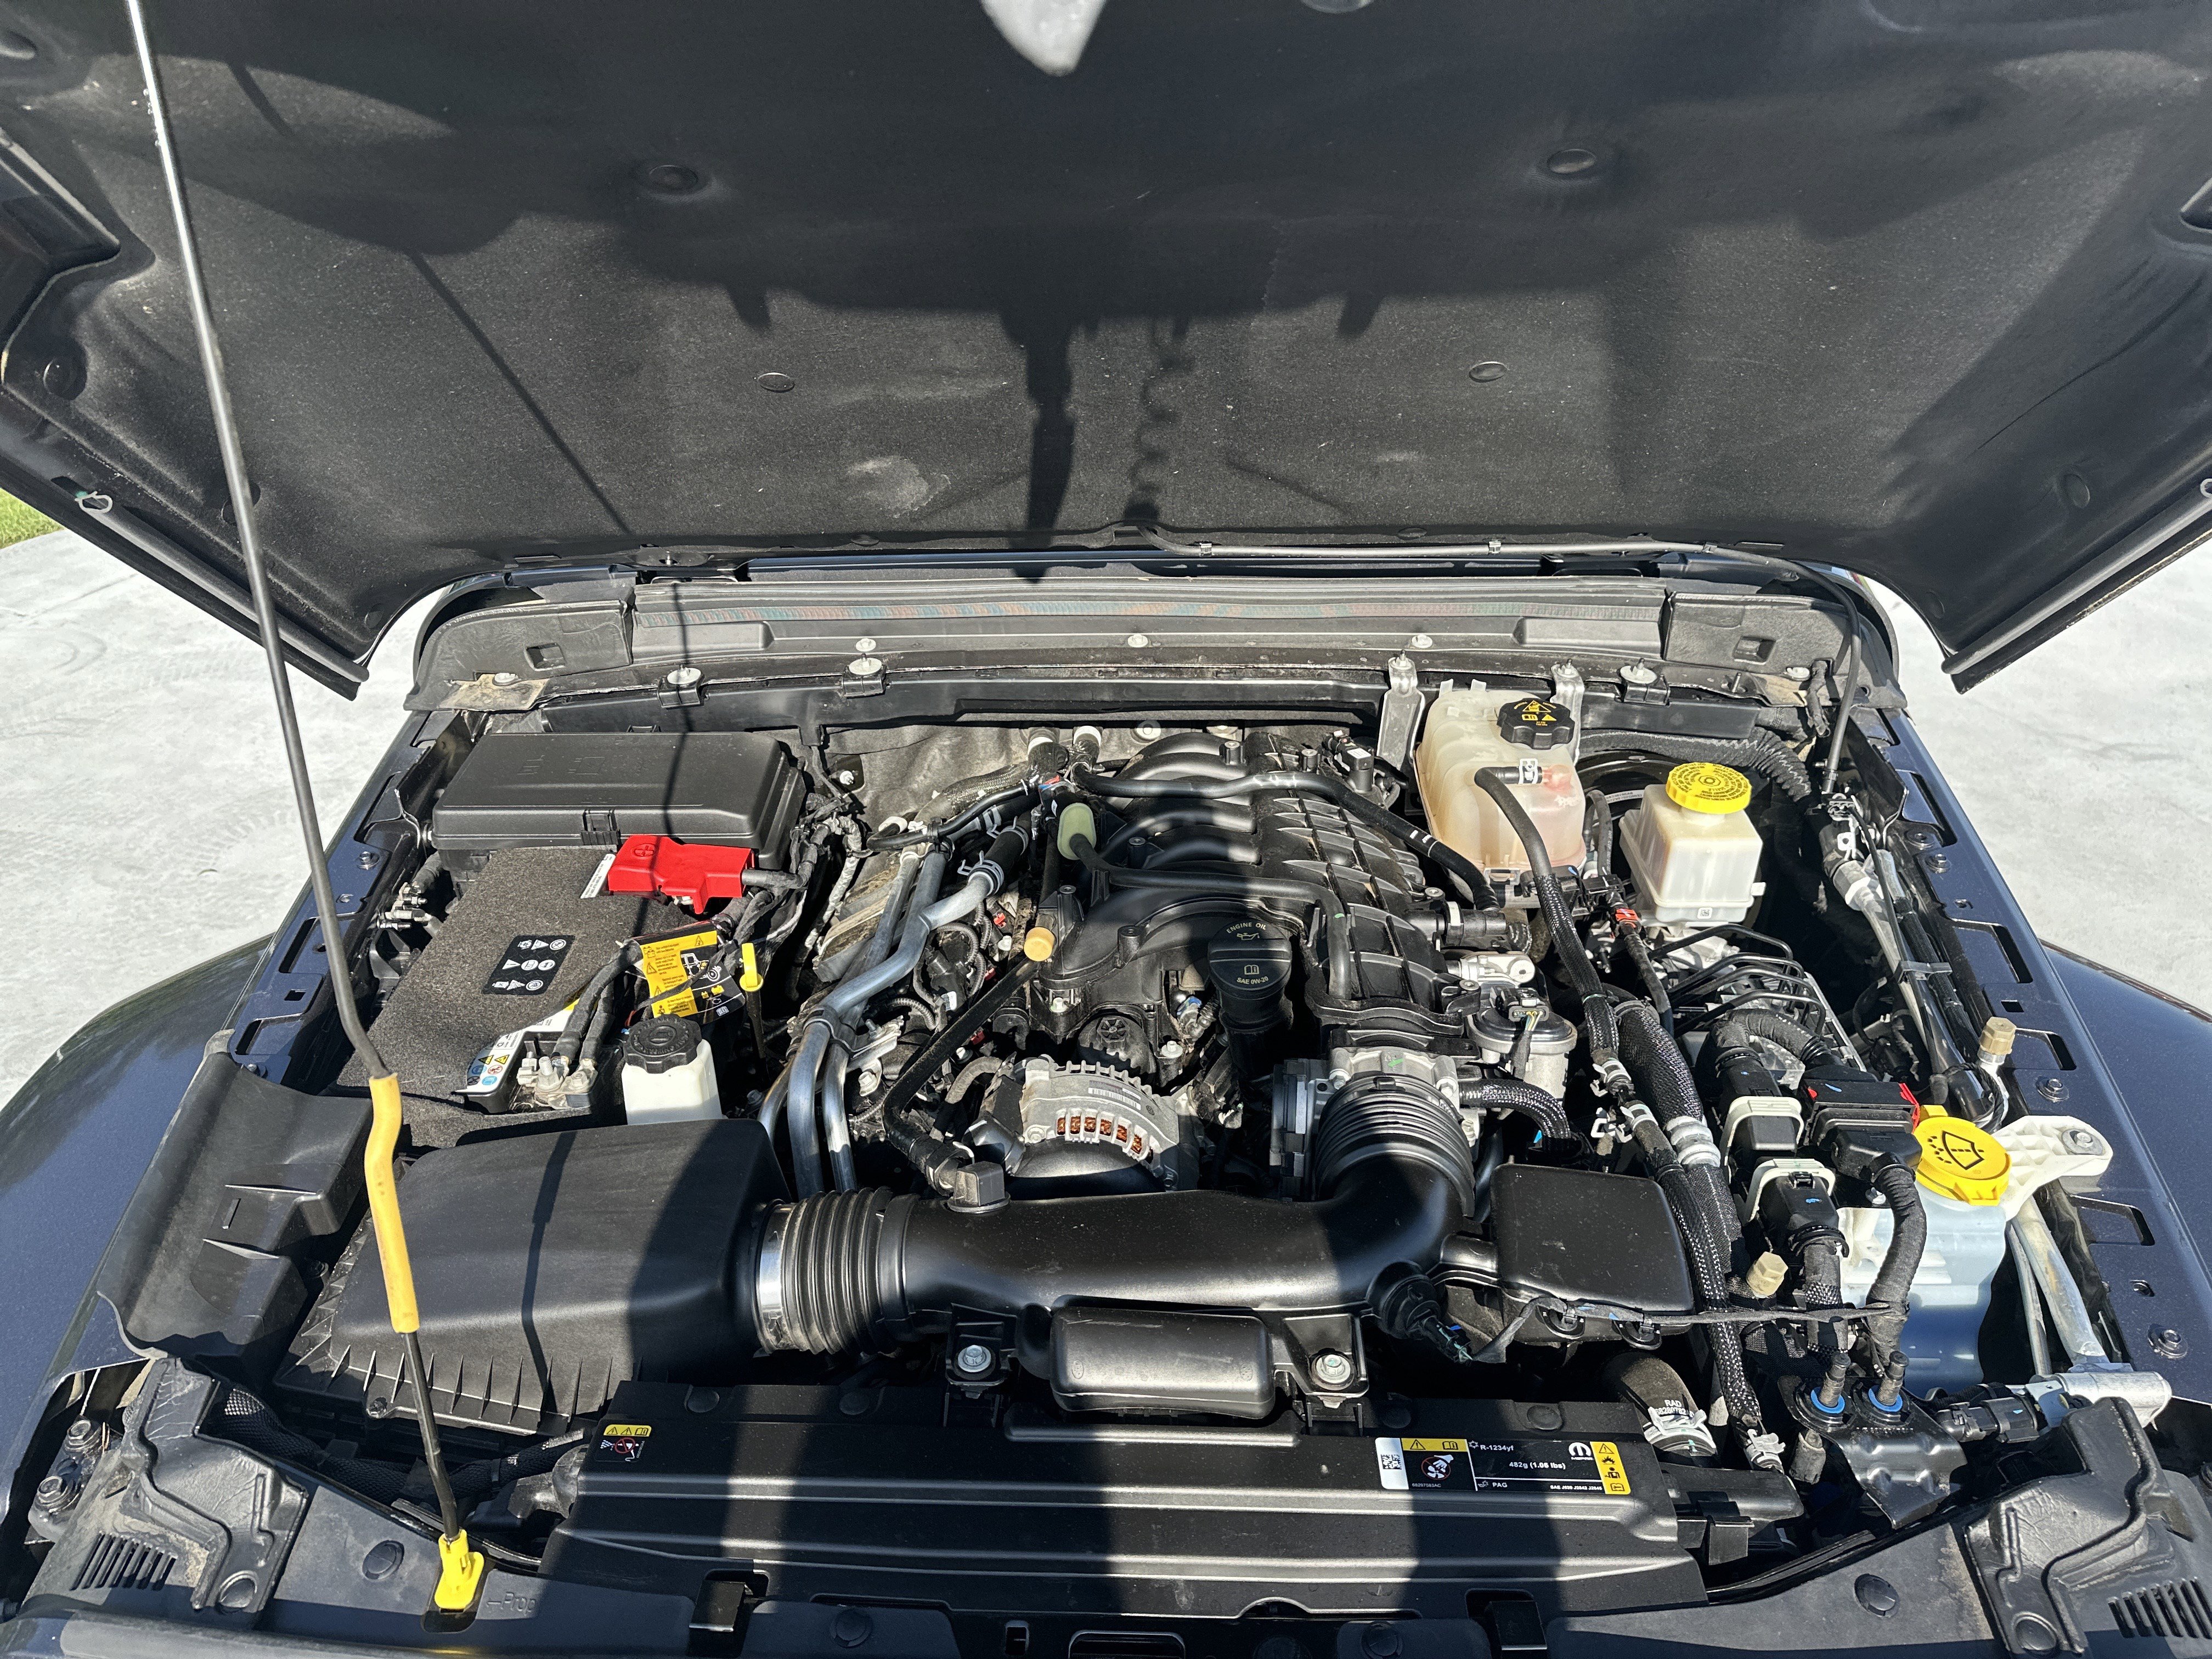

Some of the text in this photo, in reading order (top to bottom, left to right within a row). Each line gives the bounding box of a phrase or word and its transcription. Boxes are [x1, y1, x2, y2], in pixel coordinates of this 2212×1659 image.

[1226, 922, 1252, 933] ENGINE
[1250, 976, 1269, 985] 0W-20
[501, 1592, 537, 1617] Prop
